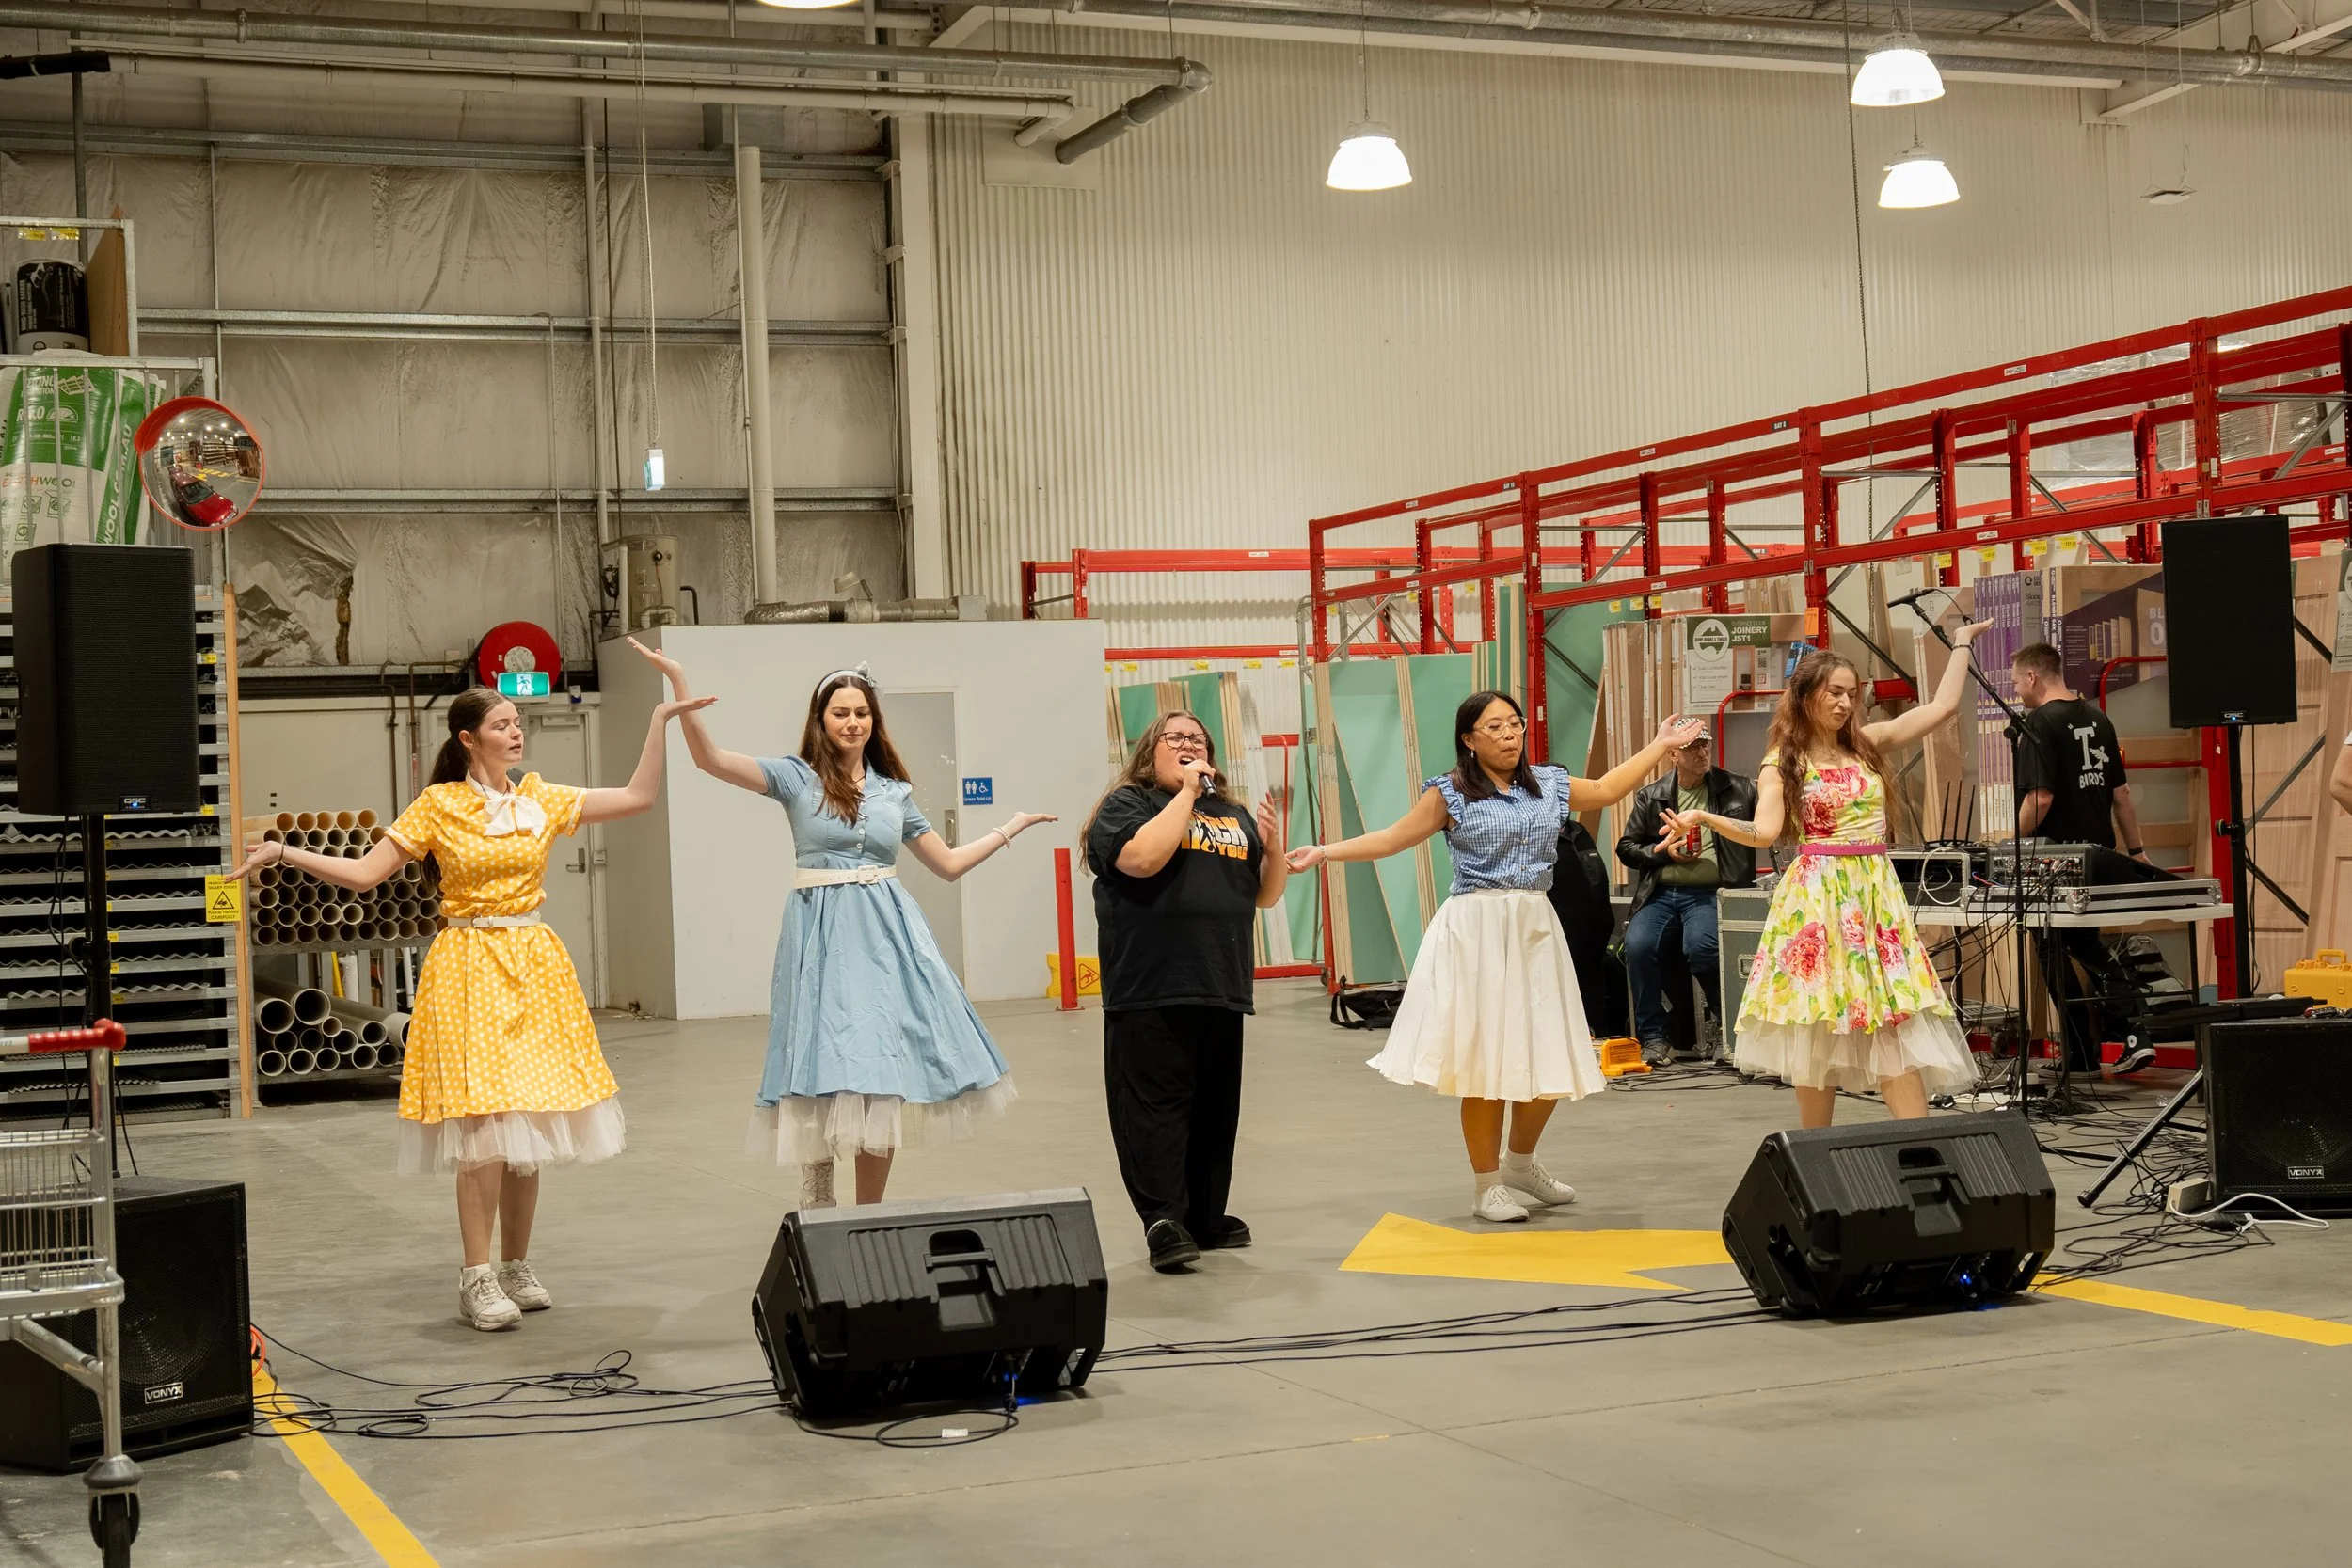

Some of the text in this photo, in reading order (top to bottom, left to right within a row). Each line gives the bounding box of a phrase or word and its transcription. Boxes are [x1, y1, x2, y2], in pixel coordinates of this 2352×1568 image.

[1731, 626, 1768, 634] JOINERY
[1732, 634, 1751, 642] JST1
[2079, 772, 2105, 789] BIRDS
[1216, 842, 1248, 860] YOU
[146, 1386, 183, 1401] VONYX
